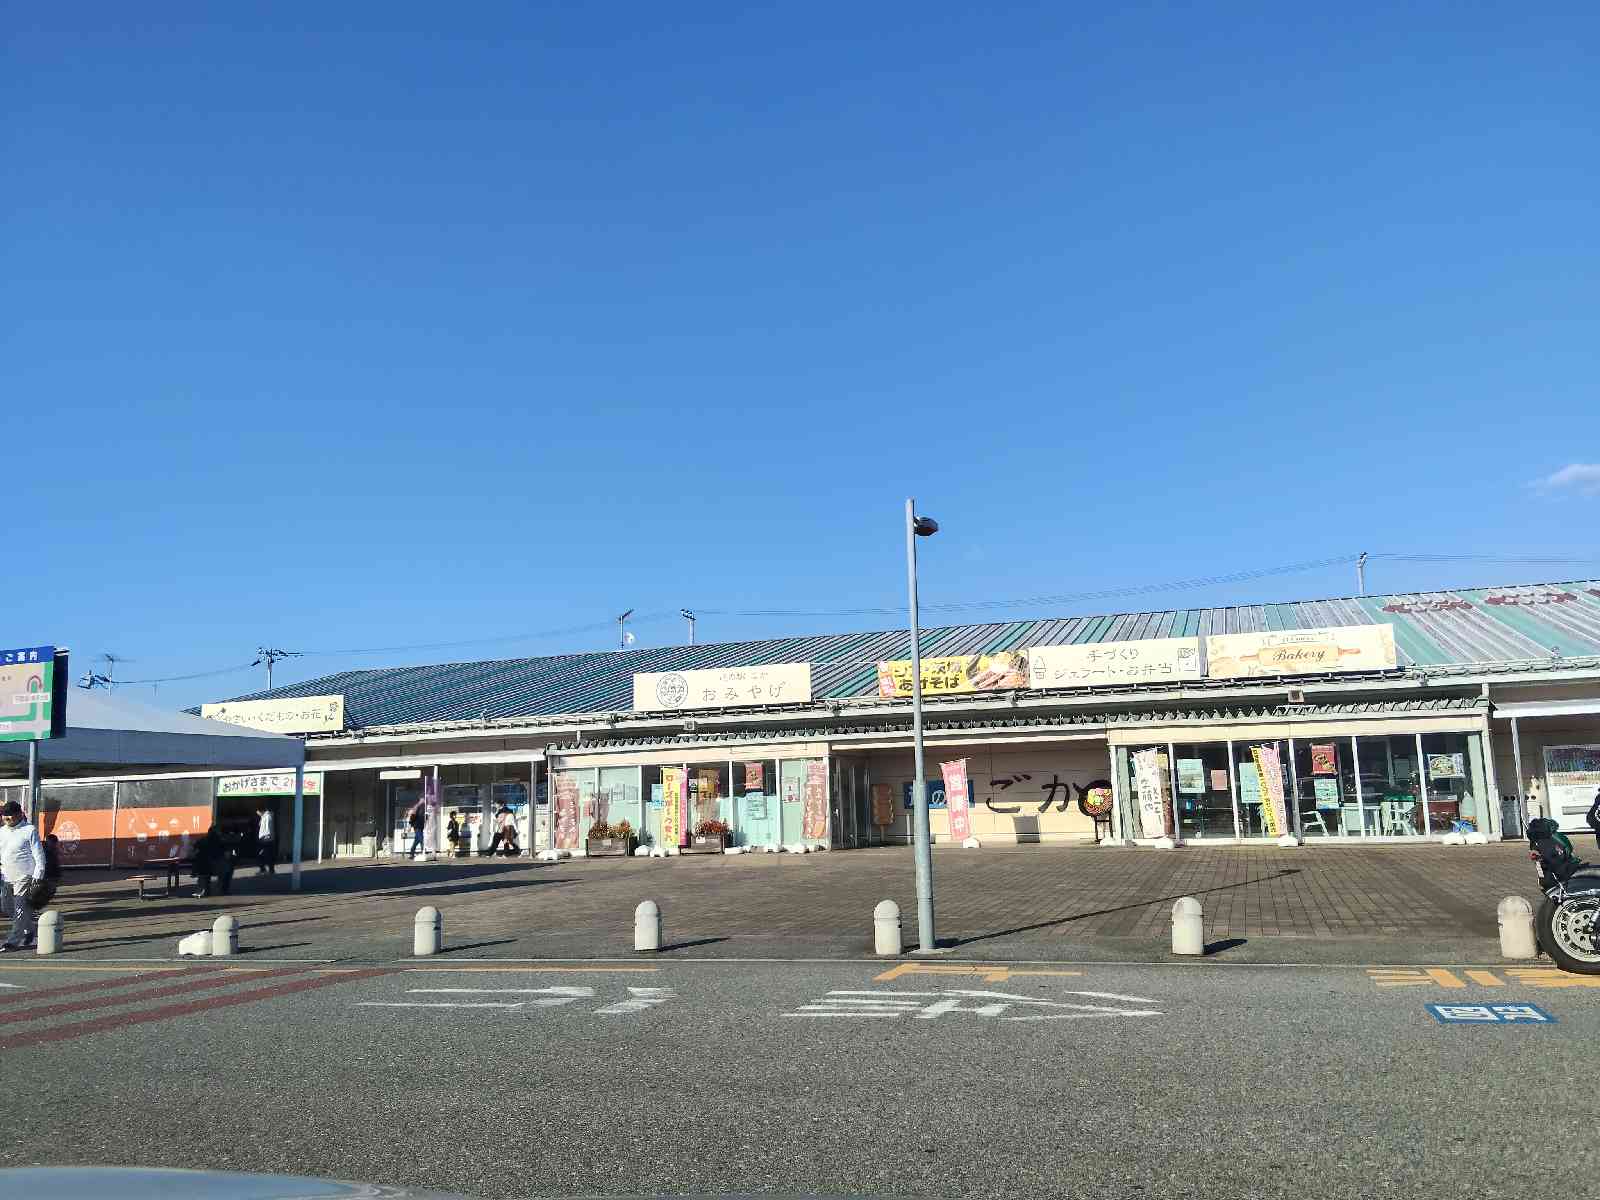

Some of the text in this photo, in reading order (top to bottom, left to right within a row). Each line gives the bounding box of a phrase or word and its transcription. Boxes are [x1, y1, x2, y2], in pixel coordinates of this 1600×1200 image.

[1088, 648, 1140, 663] 手づくり
[1272, 648, 1326, 662] Bakery
[1054, 663, 1173, 680] ジェラート・お弁当
[702, 681, 788, 702] おみやげ
[986, 775, 1082, 815] ごか
